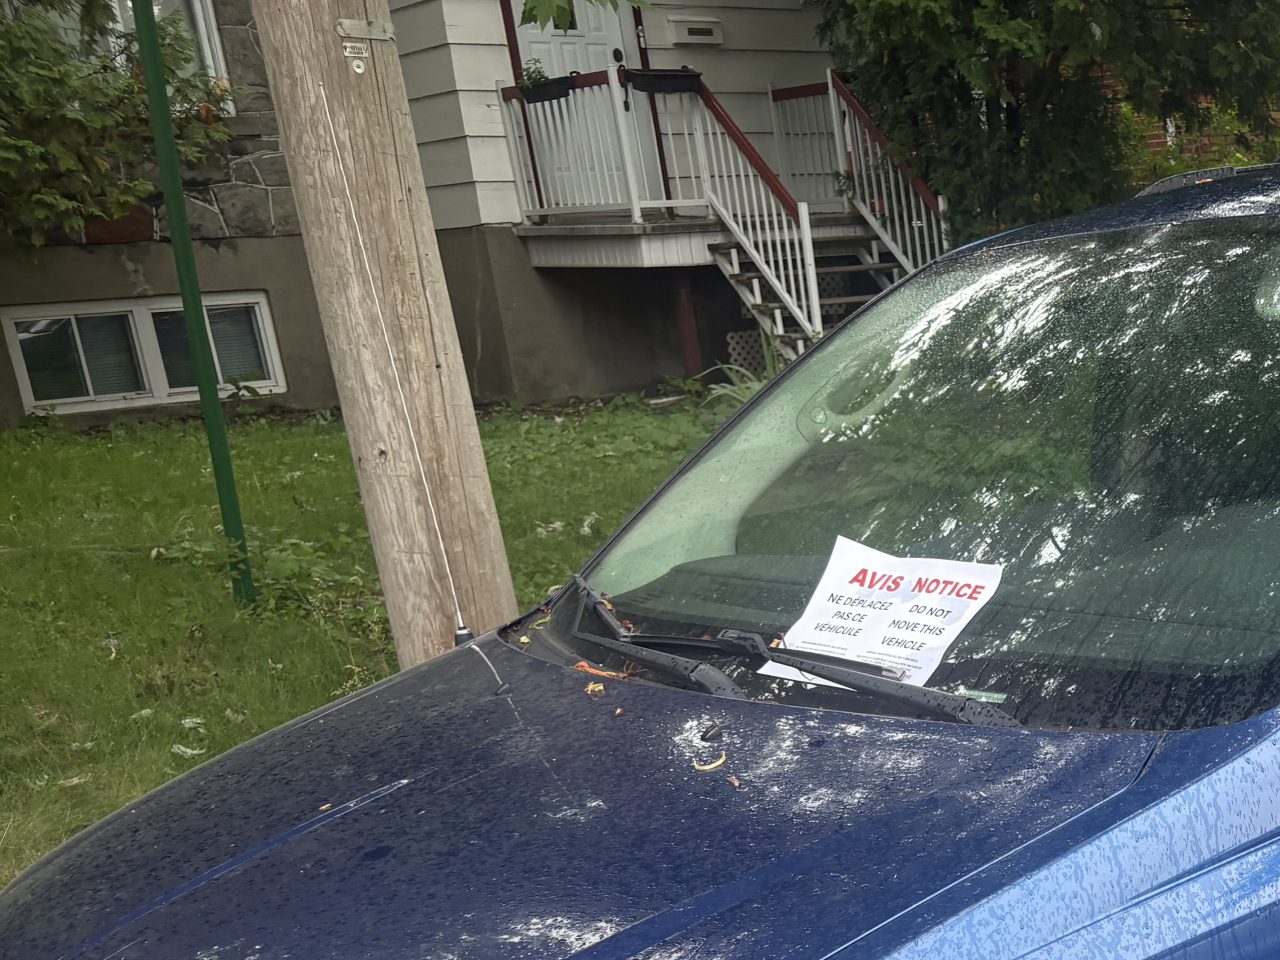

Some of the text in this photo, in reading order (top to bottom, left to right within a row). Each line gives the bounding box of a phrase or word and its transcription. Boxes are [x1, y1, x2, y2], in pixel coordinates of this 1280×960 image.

[848, 568, 986, 601] AVIS NOTICE
[827, 593, 893, 611] NE DÉPLACEZ
[831, 610, 867, 623] PAS CE
[909, 604, 952, 619] DO NOT
[813, 621, 863, 637] VÉHICULE
[888, 619, 945, 636] MOVE THIS
[881, 635, 926, 651] VEHICLE
